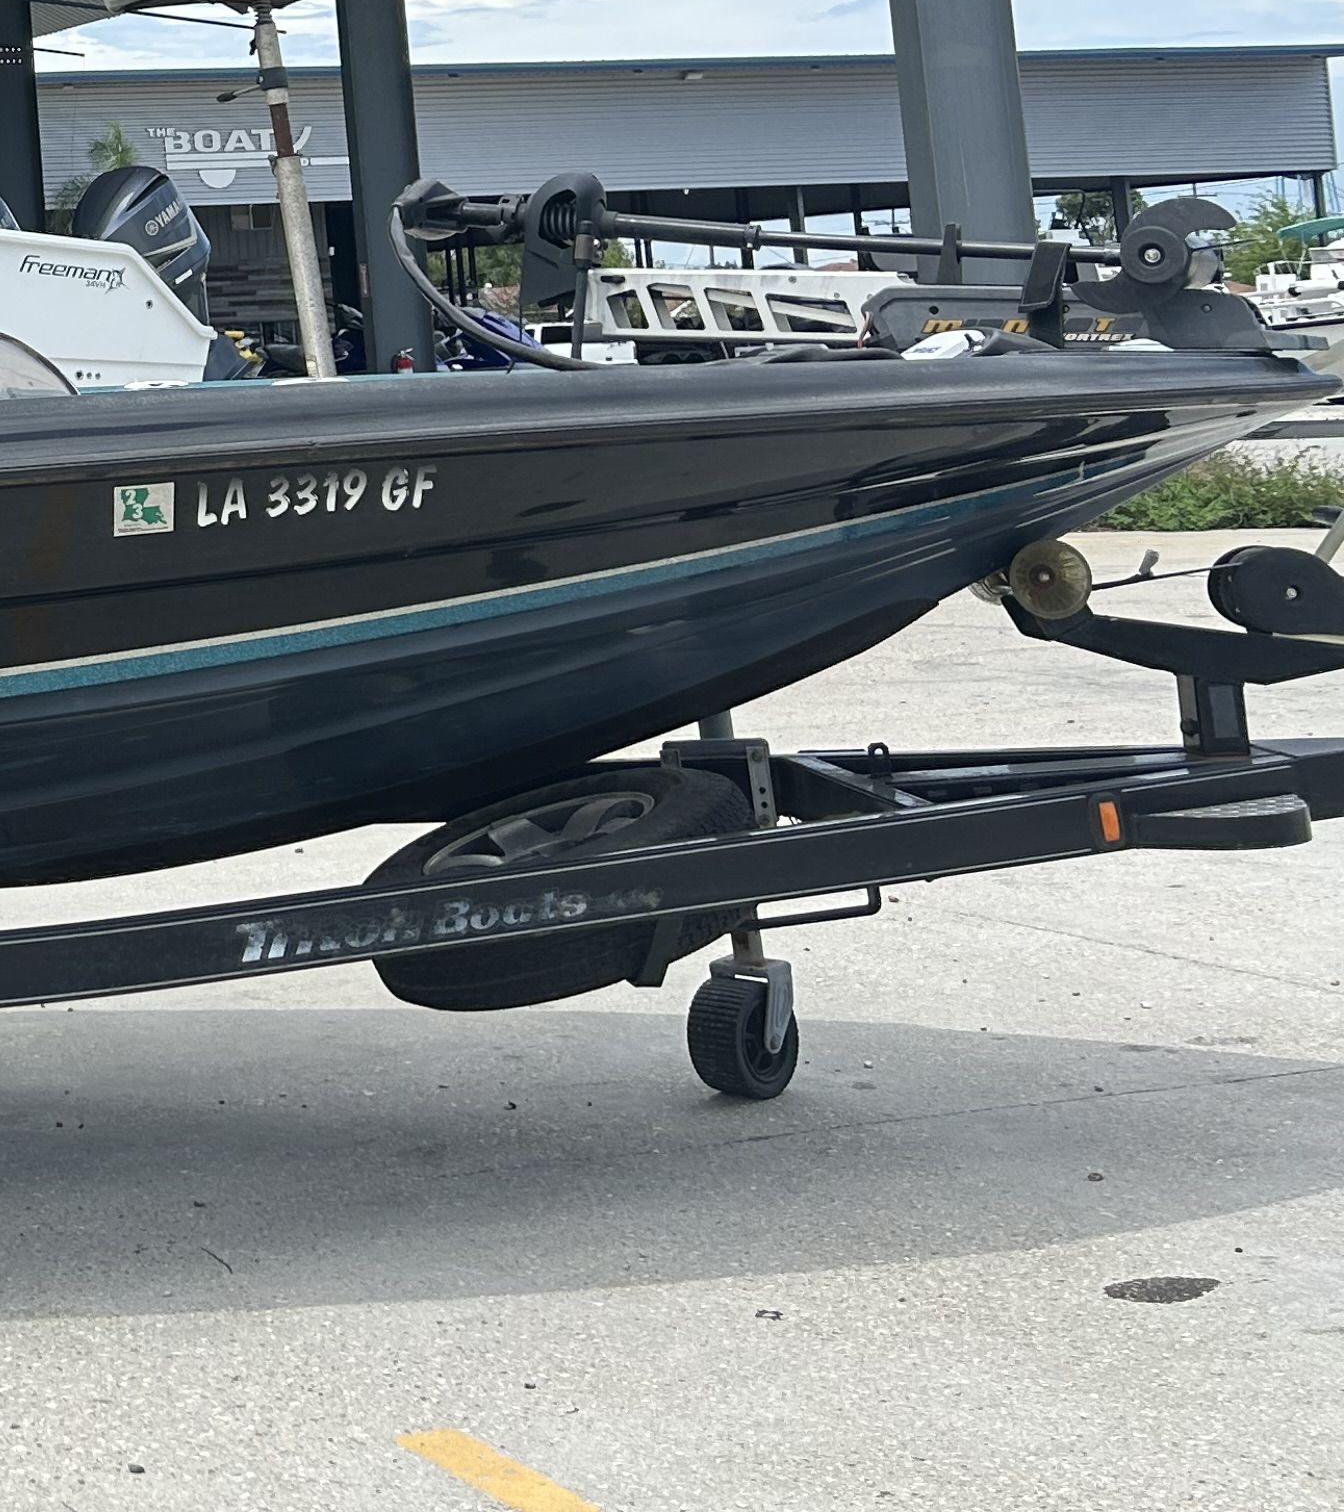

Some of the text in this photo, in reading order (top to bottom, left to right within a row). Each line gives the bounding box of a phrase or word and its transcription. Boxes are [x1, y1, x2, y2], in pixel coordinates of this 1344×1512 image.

[146, 128, 176, 138] THE
[165, 128, 275, 154] BOAT
[154, 201, 183, 228] YAMA
[1063, 333, 1136, 342] ORTREX
[125, 489, 137, 506] 2
[196, 463, 438, 528] LA 3319 GF
[132, 503, 144, 519] 3
